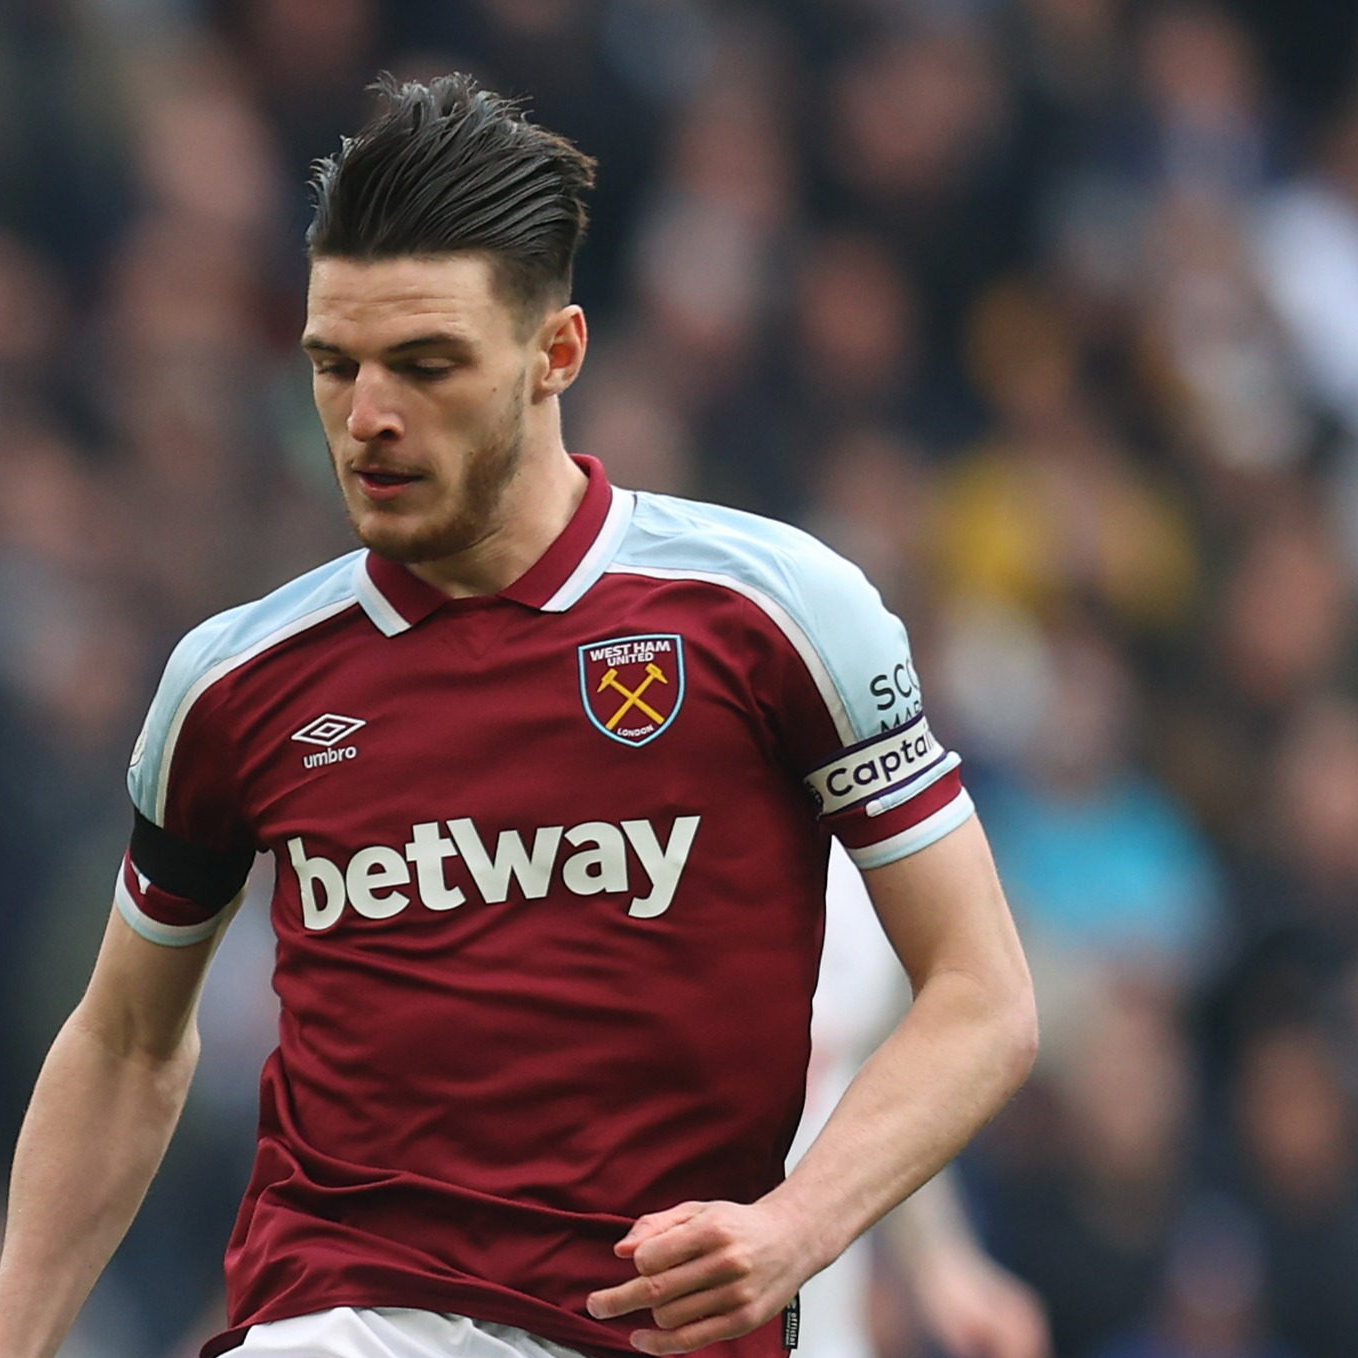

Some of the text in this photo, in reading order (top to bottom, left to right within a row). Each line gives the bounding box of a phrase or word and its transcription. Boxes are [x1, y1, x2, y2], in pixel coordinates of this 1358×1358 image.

[590, 641, 671, 661] WEST HAM
[607, 652, 654, 667] UNITED
[617, 724, 654, 737] LONDON
[303, 746, 357, 769] umbro
[287, 815, 701, 931] betway
